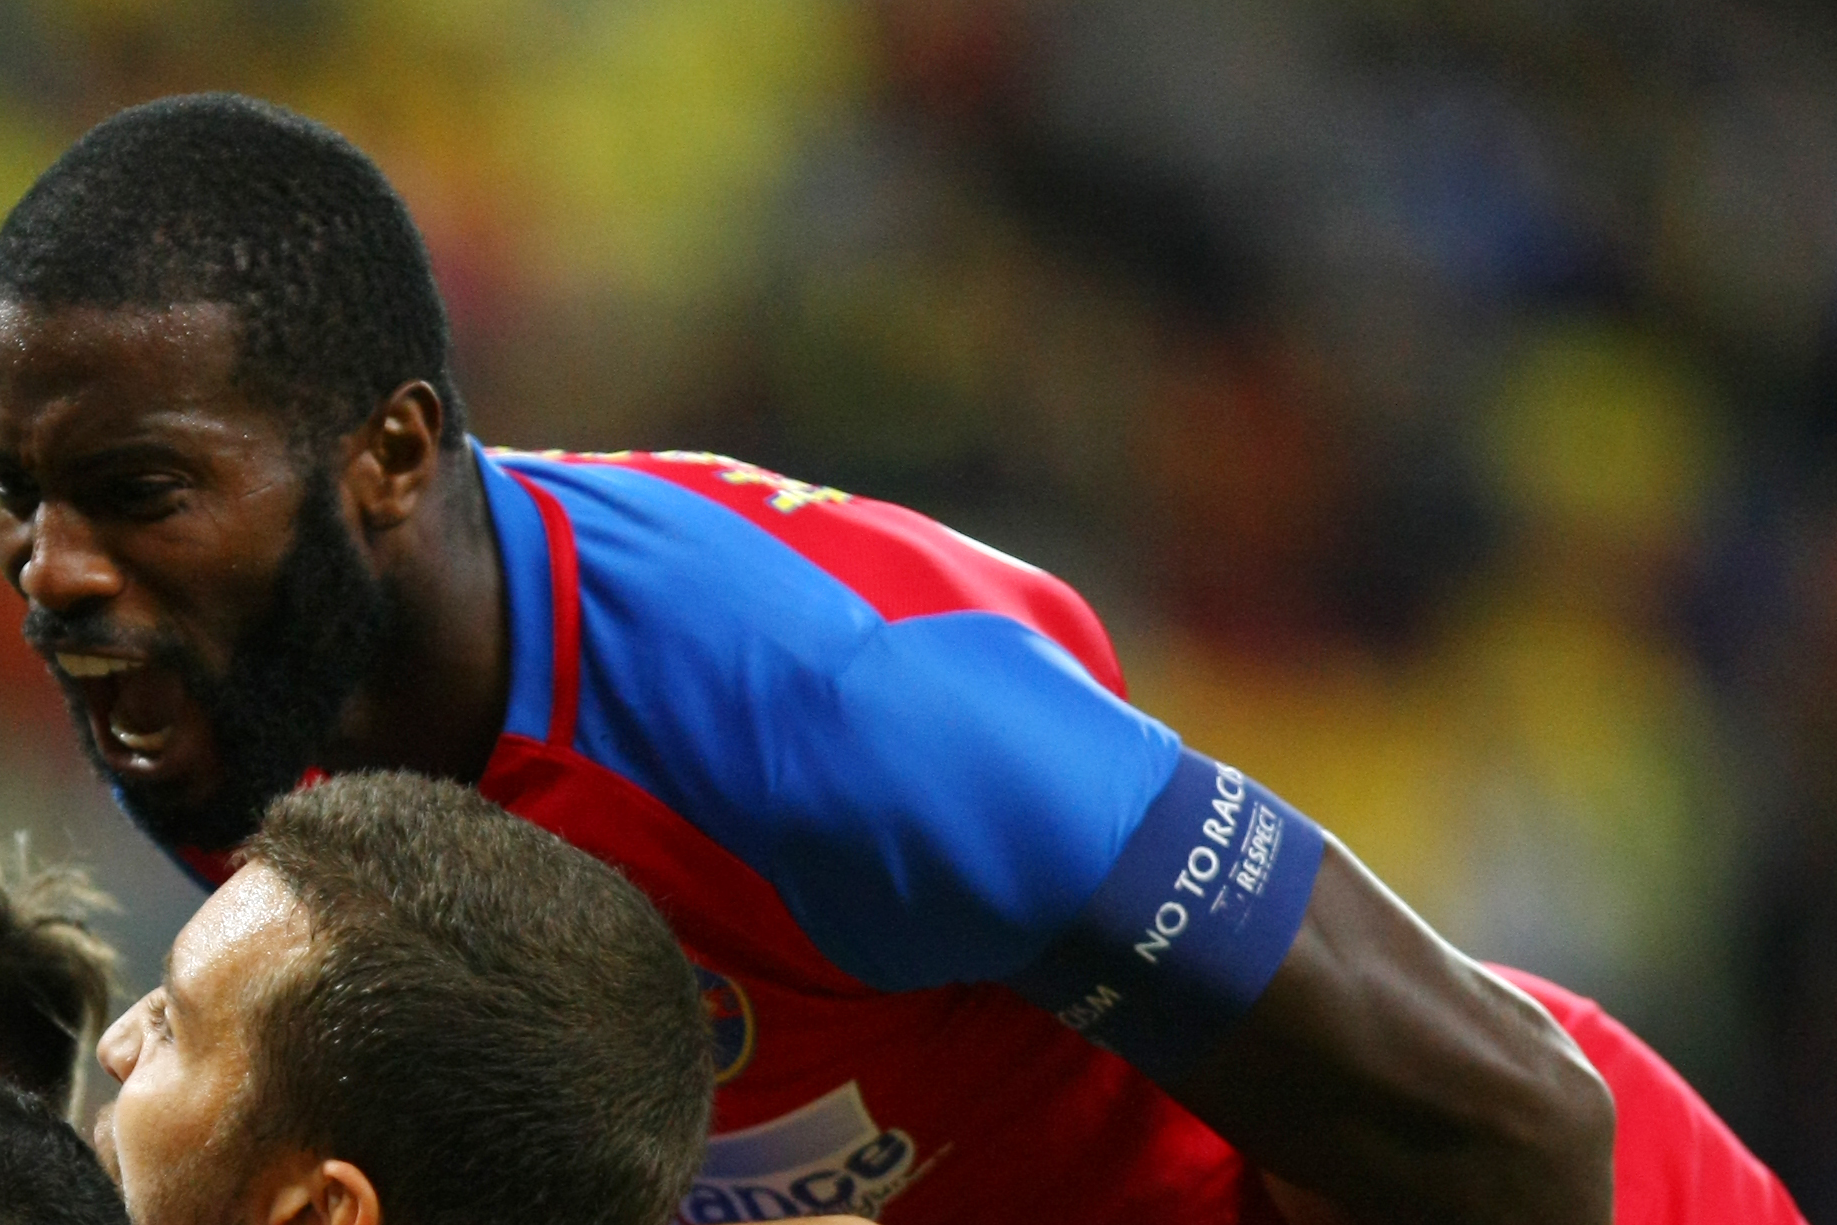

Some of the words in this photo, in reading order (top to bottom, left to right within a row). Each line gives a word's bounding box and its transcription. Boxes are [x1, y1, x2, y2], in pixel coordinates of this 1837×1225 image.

[1134, 901, 1188, 964] NO
[1174, 845, 1220, 898] TO
[1202, 761, 1245, 848] RACI
[1234, 803, 1279, 896] RESPECT
